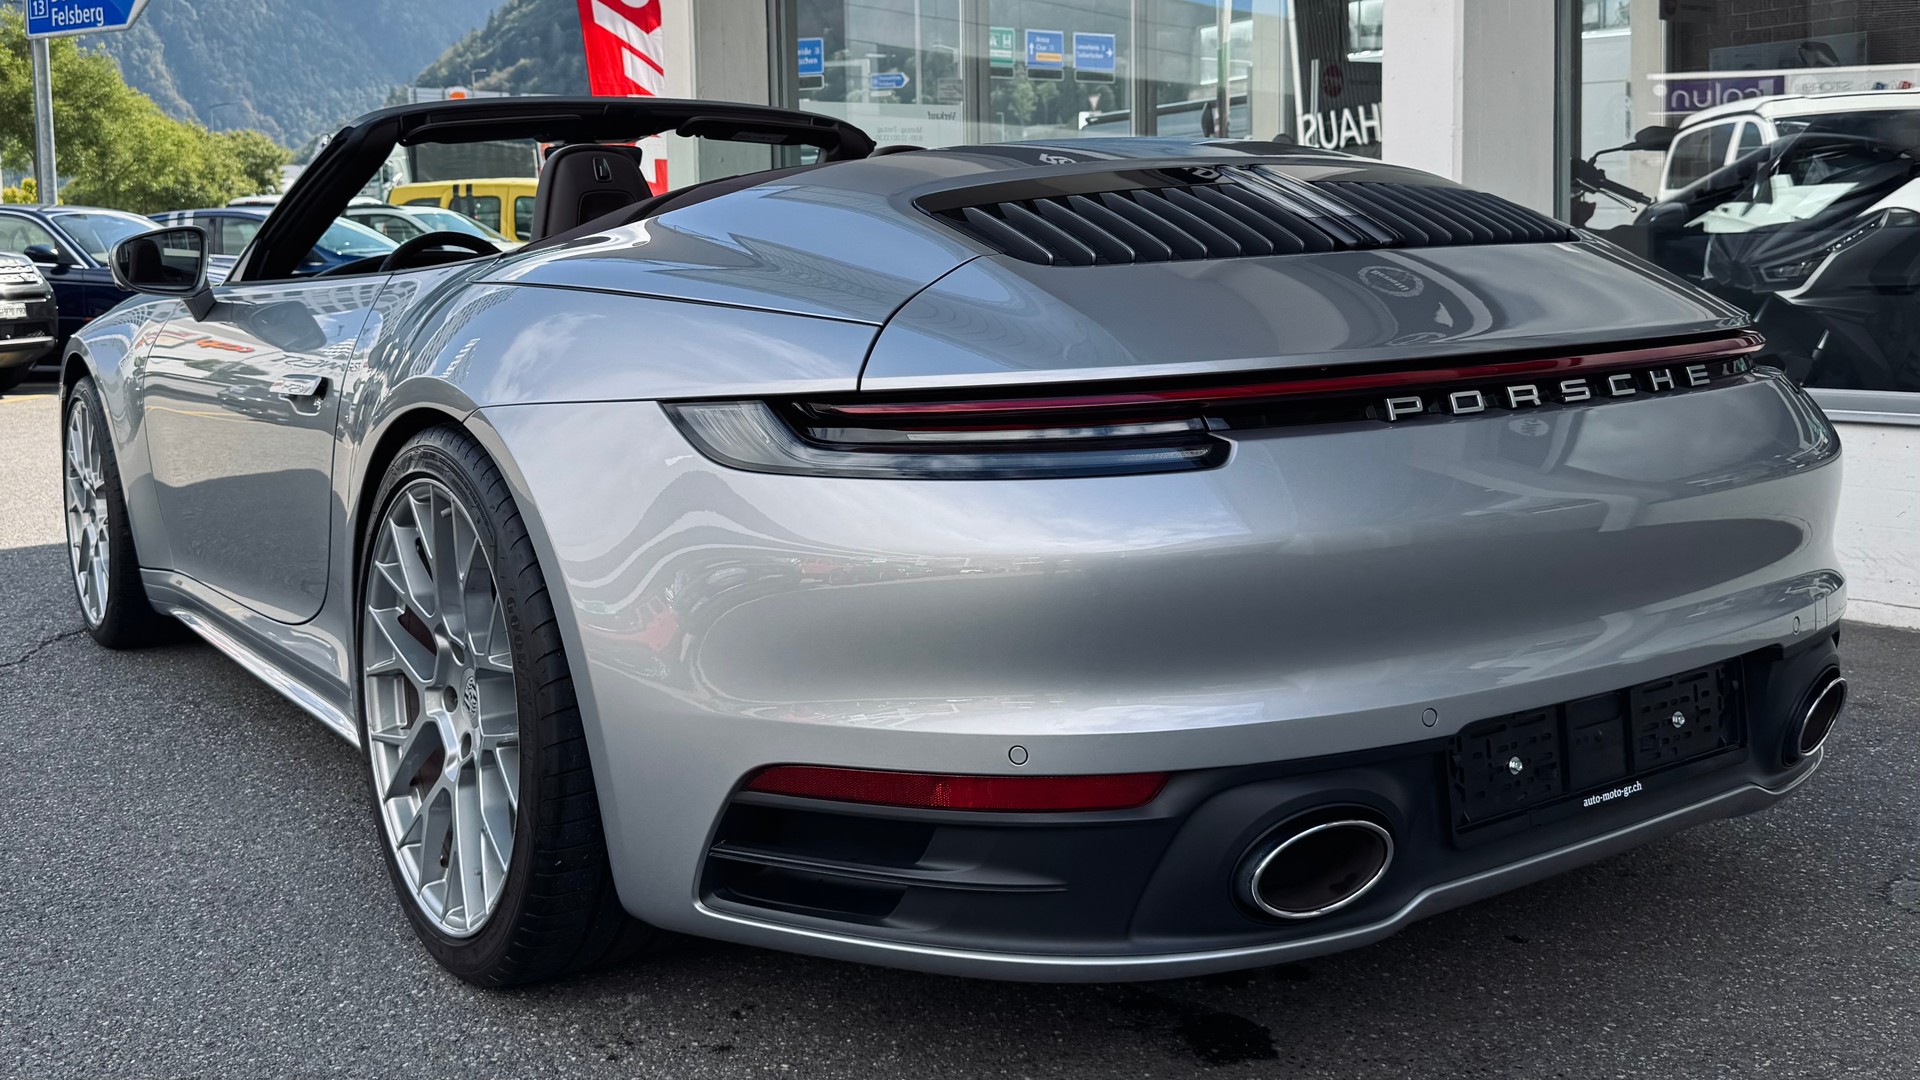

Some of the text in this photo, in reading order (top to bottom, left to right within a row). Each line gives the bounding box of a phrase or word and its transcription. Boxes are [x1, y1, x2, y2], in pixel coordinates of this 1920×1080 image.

[33, 1, 45, 16] 13
[51, 4, 104, 26] Felsberg
[1386, 364, 1711, 421] PORSCHE
[1583, 781, 1643, 807] auto-moto-gr.ch
